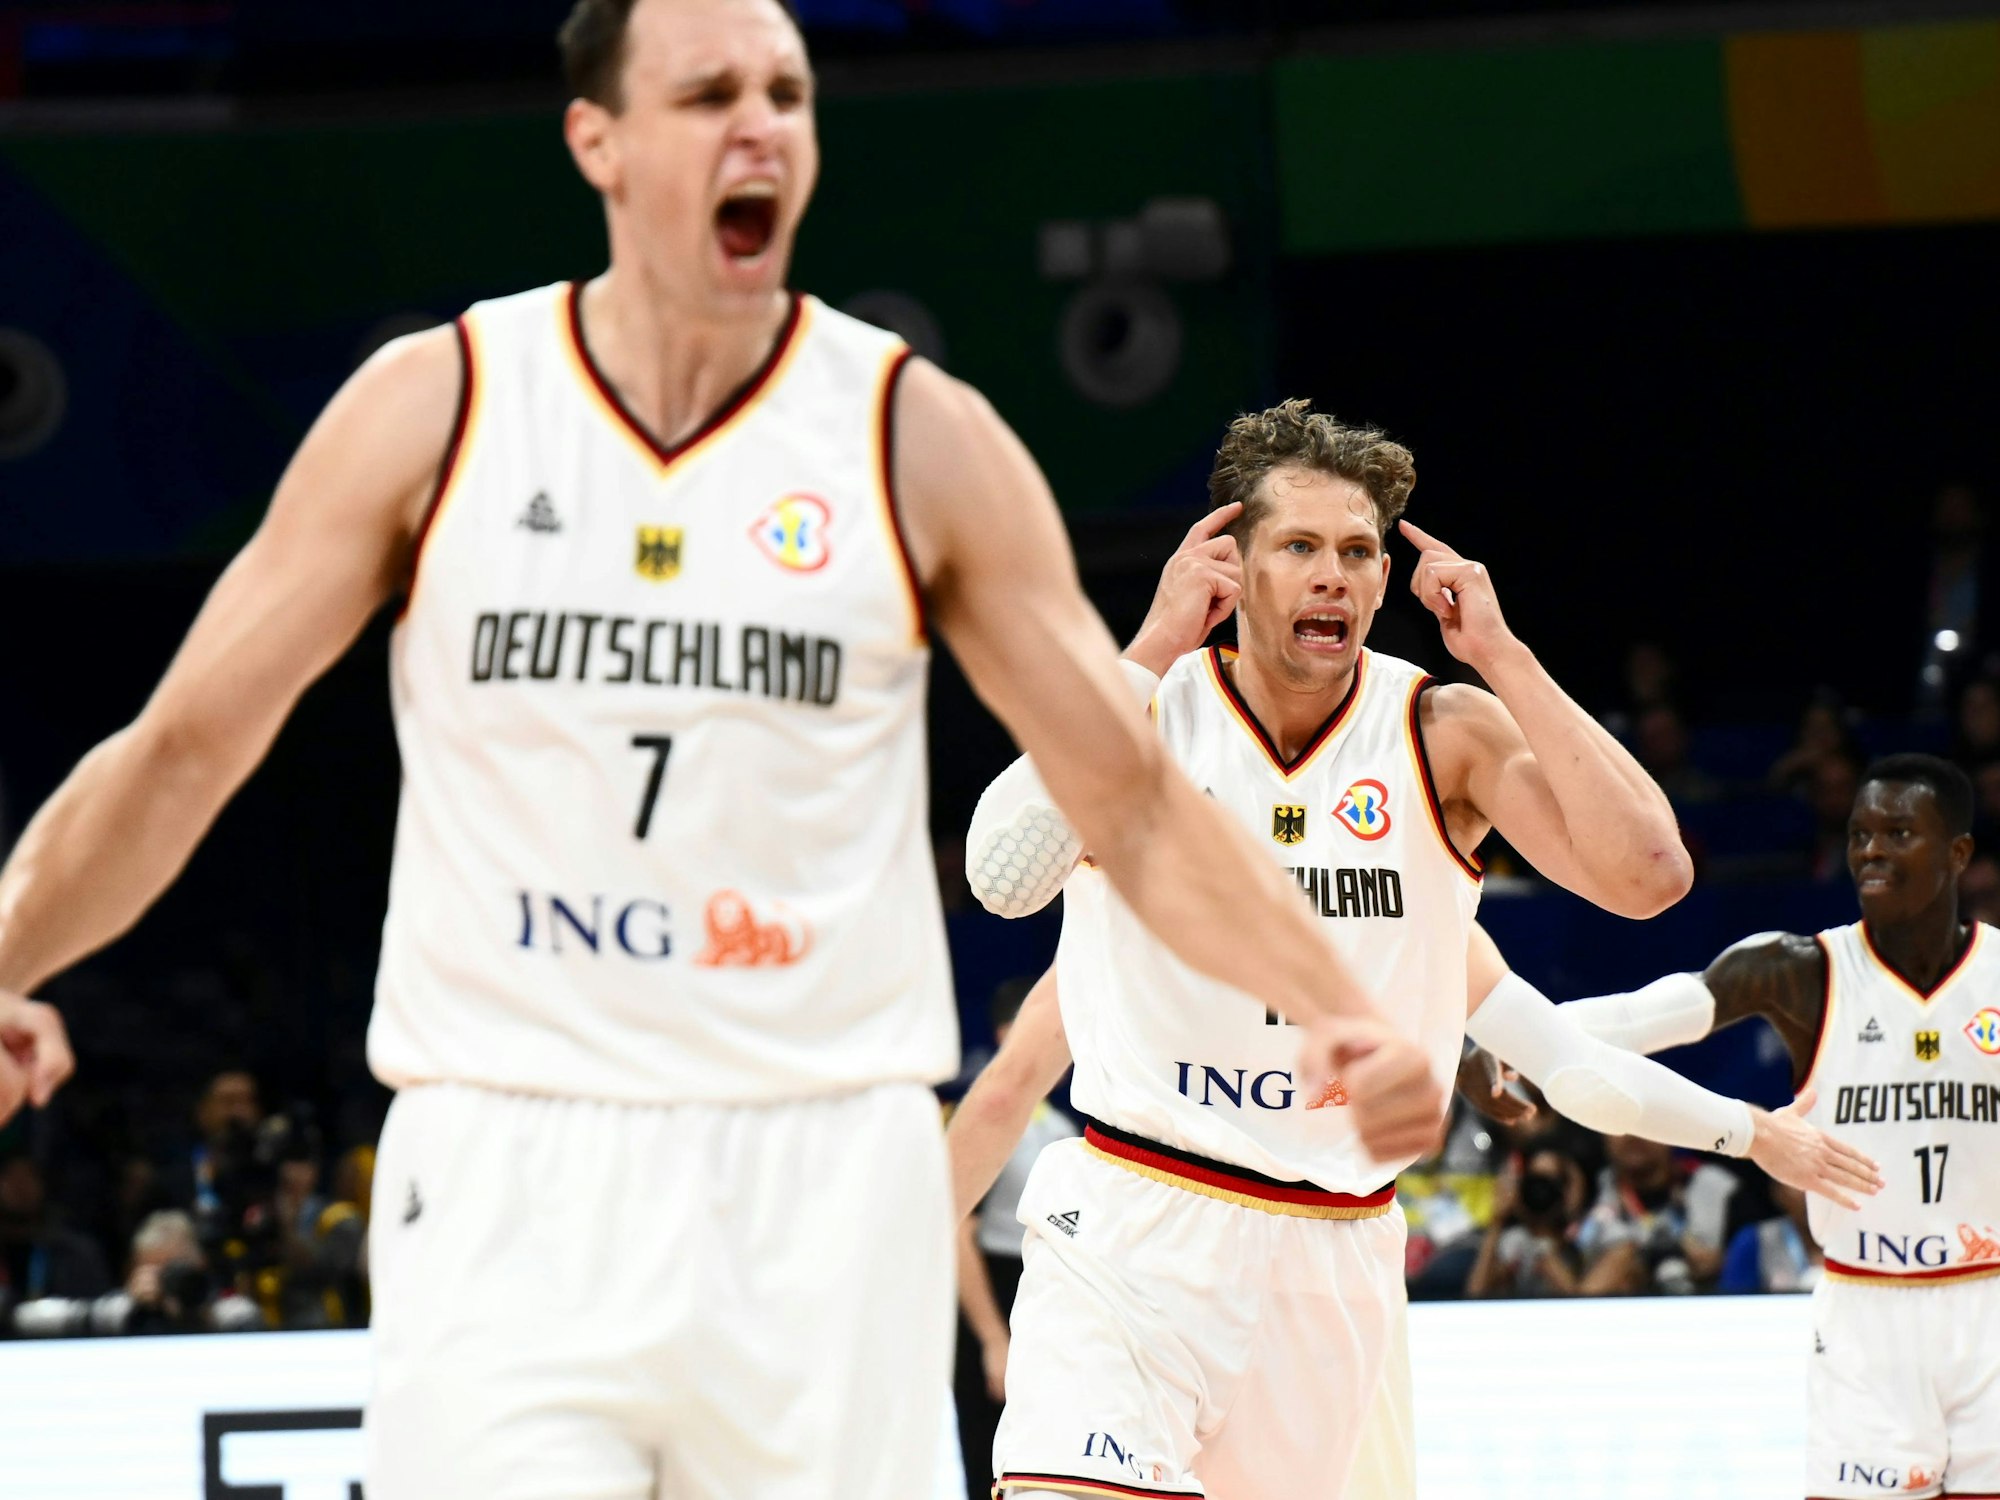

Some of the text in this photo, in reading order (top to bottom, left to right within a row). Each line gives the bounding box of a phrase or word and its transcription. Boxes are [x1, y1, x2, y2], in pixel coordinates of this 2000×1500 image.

[471, 612, 842, 708] DEUTSCHLAND
[630, 734, 673, 841] 7
[1284, 866, 1404, 918] HLAND
[519, 892, 672, 958] ING
[1174, 1061, 1296, 1110] ING
[1914, 1144, 1949, 1204] 17
[1858, 1230, 1948, 1266] ING
[1839, 1462, 1898, 1488] ING
